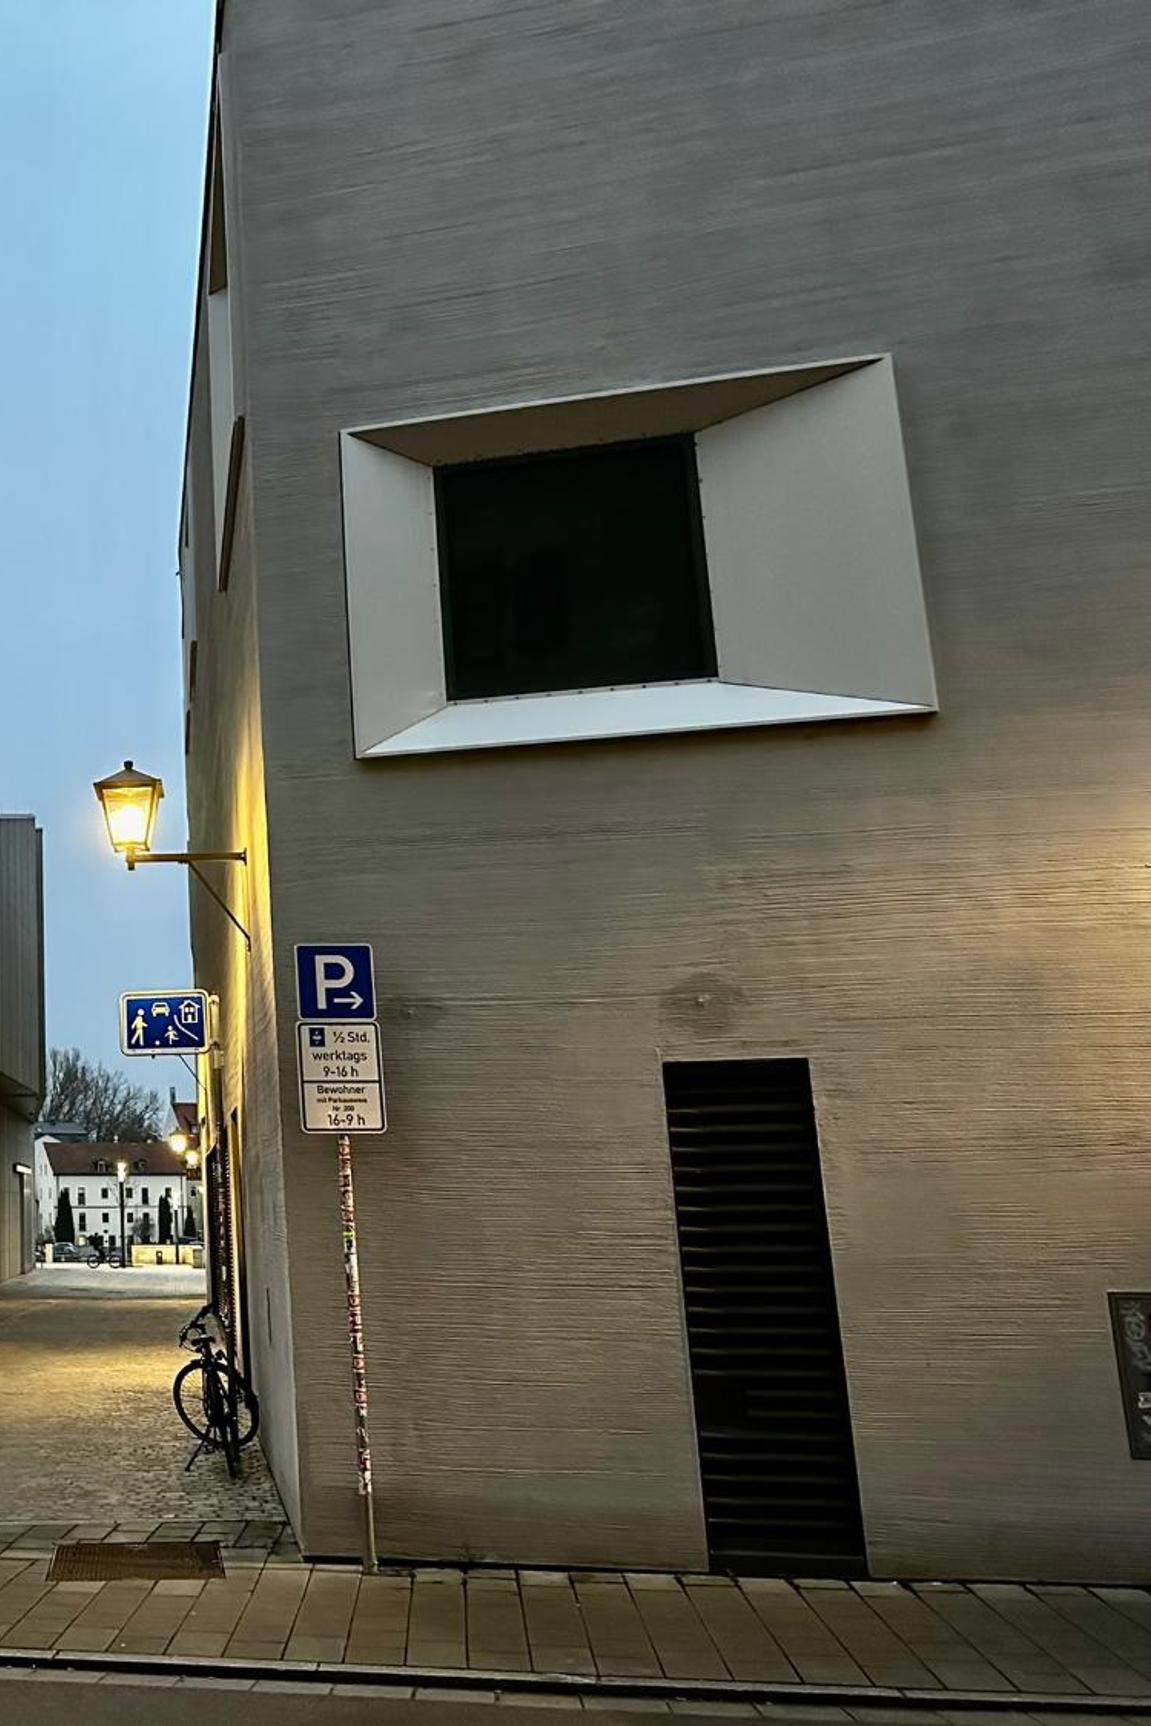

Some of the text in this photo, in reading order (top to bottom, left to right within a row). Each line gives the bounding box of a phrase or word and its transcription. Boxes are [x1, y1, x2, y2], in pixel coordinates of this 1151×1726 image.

[314, 955, 355, 1009] P
[347, 1031, 370, 1043] Std.
[312, 1050, 368, 1063] werktags
[323, 1066, 359, 1077] 9-16 h
[316, 1085, 366, 1094] Bewohner
[328, 1114, 366, 1126] 16-9 h
